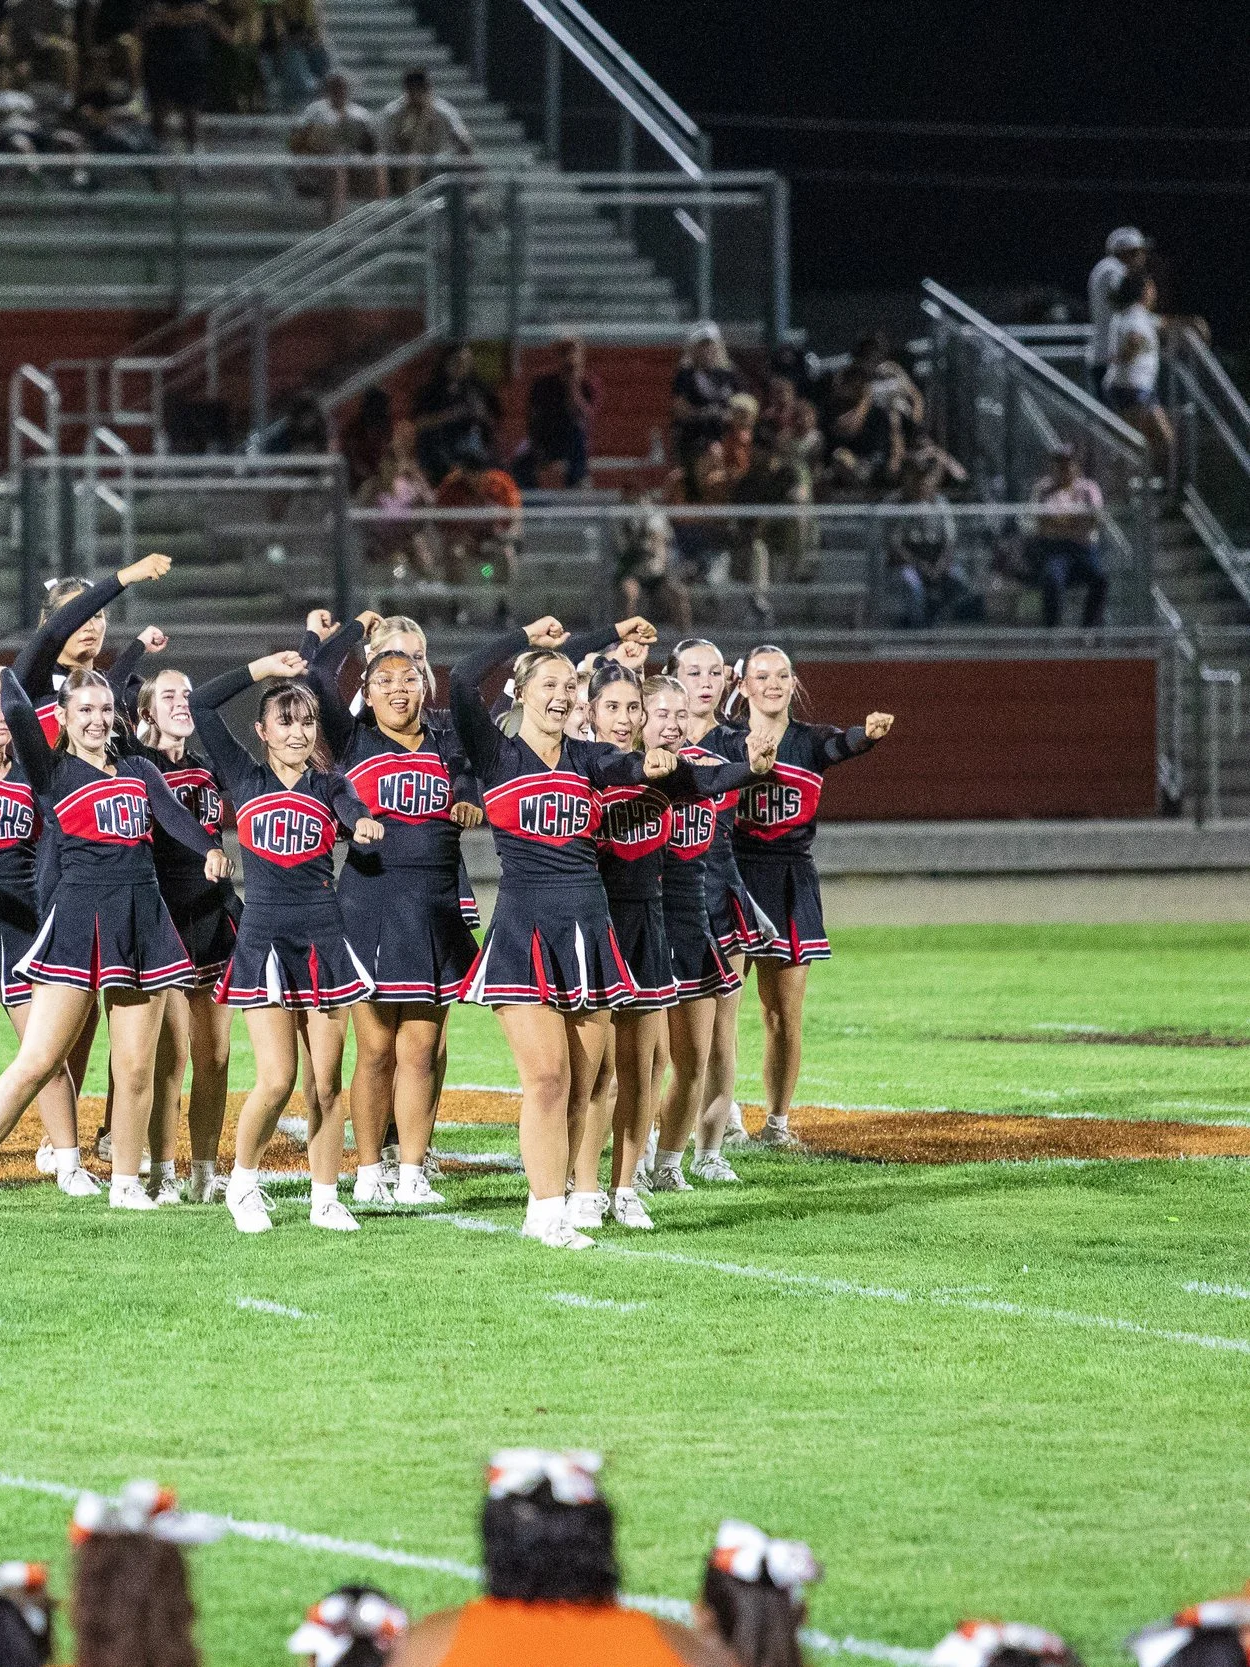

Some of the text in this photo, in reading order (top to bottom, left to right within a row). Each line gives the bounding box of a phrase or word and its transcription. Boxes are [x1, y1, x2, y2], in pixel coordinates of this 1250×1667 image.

[172, 783, 221, 826] CHS
[378, 771, 450, 816] WCHS
[518, 791, 591, 838] WCHS
[251, 808, 323, 856] WCHS
[669, 802, 713, 848] CHS
